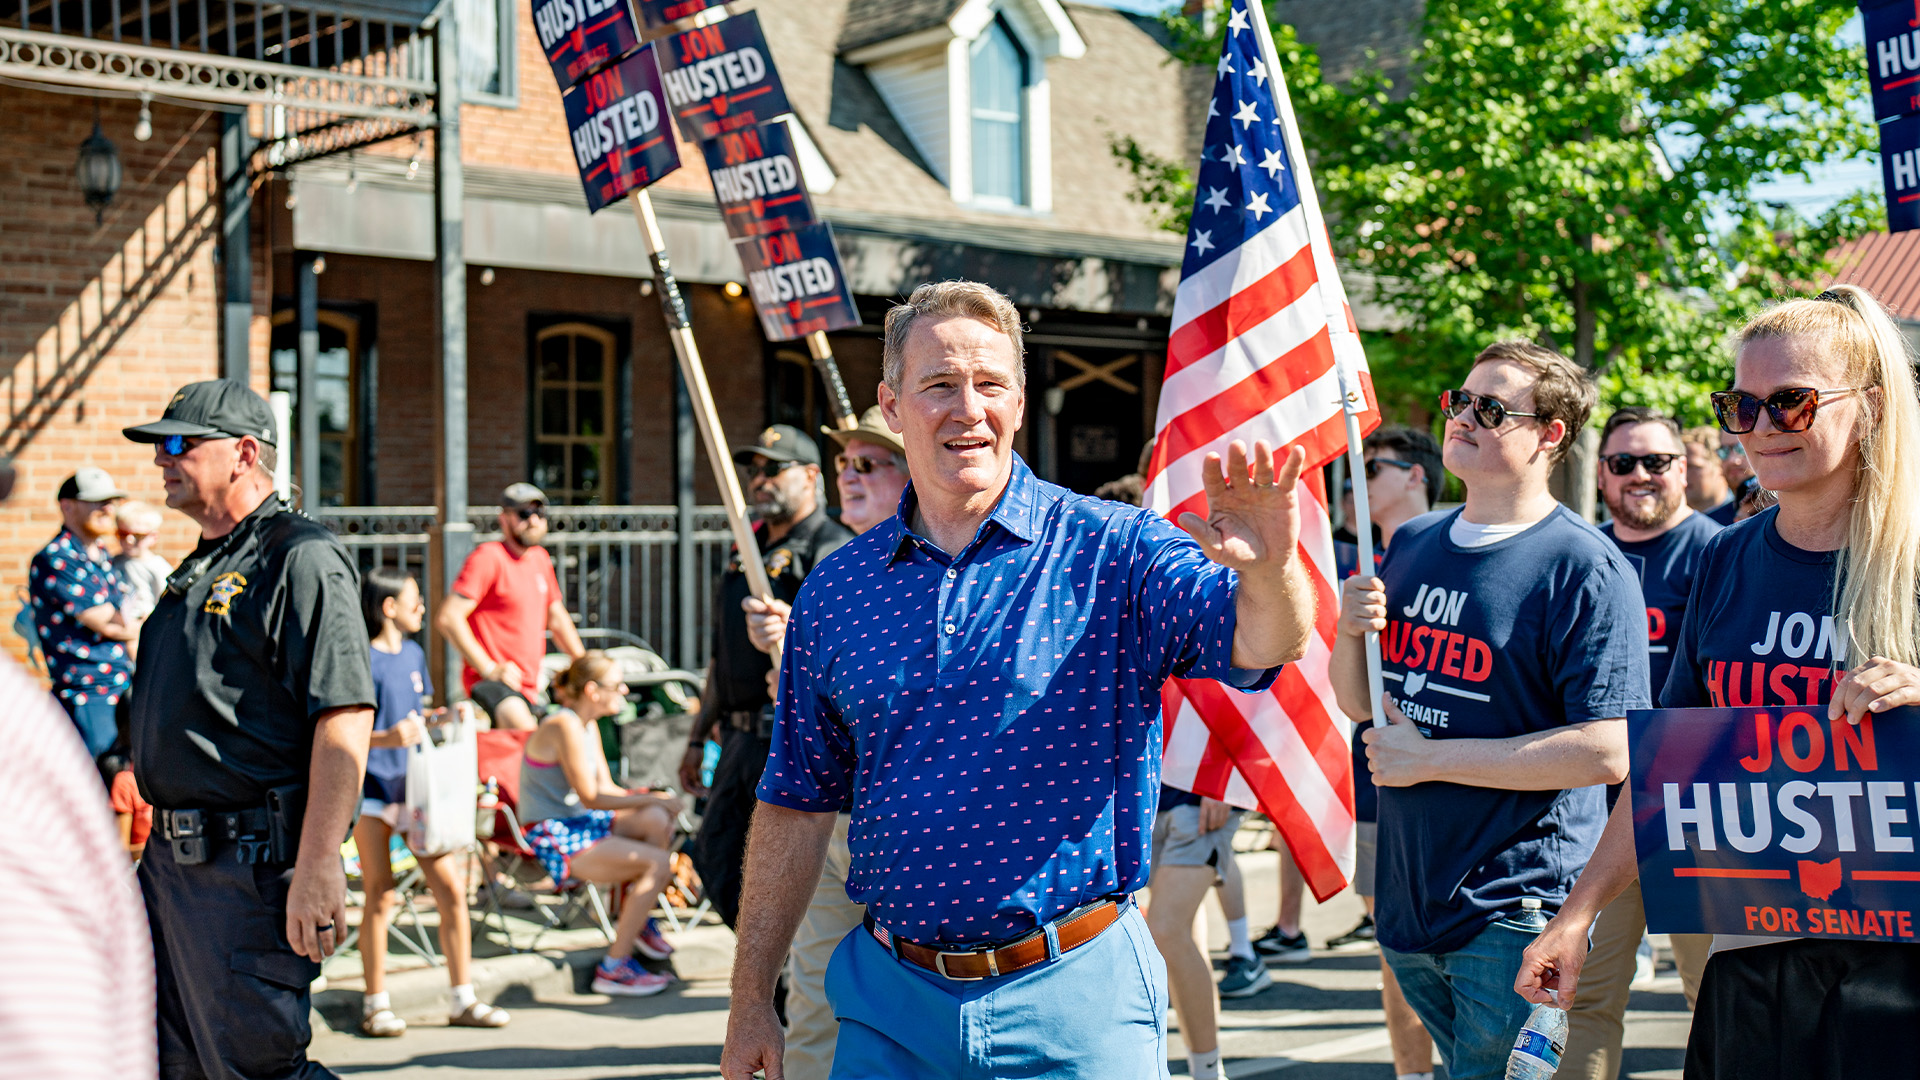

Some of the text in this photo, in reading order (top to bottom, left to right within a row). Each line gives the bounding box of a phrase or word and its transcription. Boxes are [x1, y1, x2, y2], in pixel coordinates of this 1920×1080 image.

[679, 24, 726, 64] JON
[584, 64, 624, 115] JON
[664, 46, 766, 106] HUSTED
[573, 90, 659, 169] HUSTED
[722, 129, 763, 165] JON
[711, 154, 797, 204] HUSTED
[759, 231, 802, 267] JON
[749, 257, 835, 304] HUSTED
[1403, 583, 1468, 627] JON
[1750, 611, 1849, 661] JON
[1400, 699, 1449, 728] SENATE
[1739, 711, 1878, 773] JON
[1662, 780, 1920, 854] HUSTE
[1744, 906, 1914, 938] FOR SENATE
